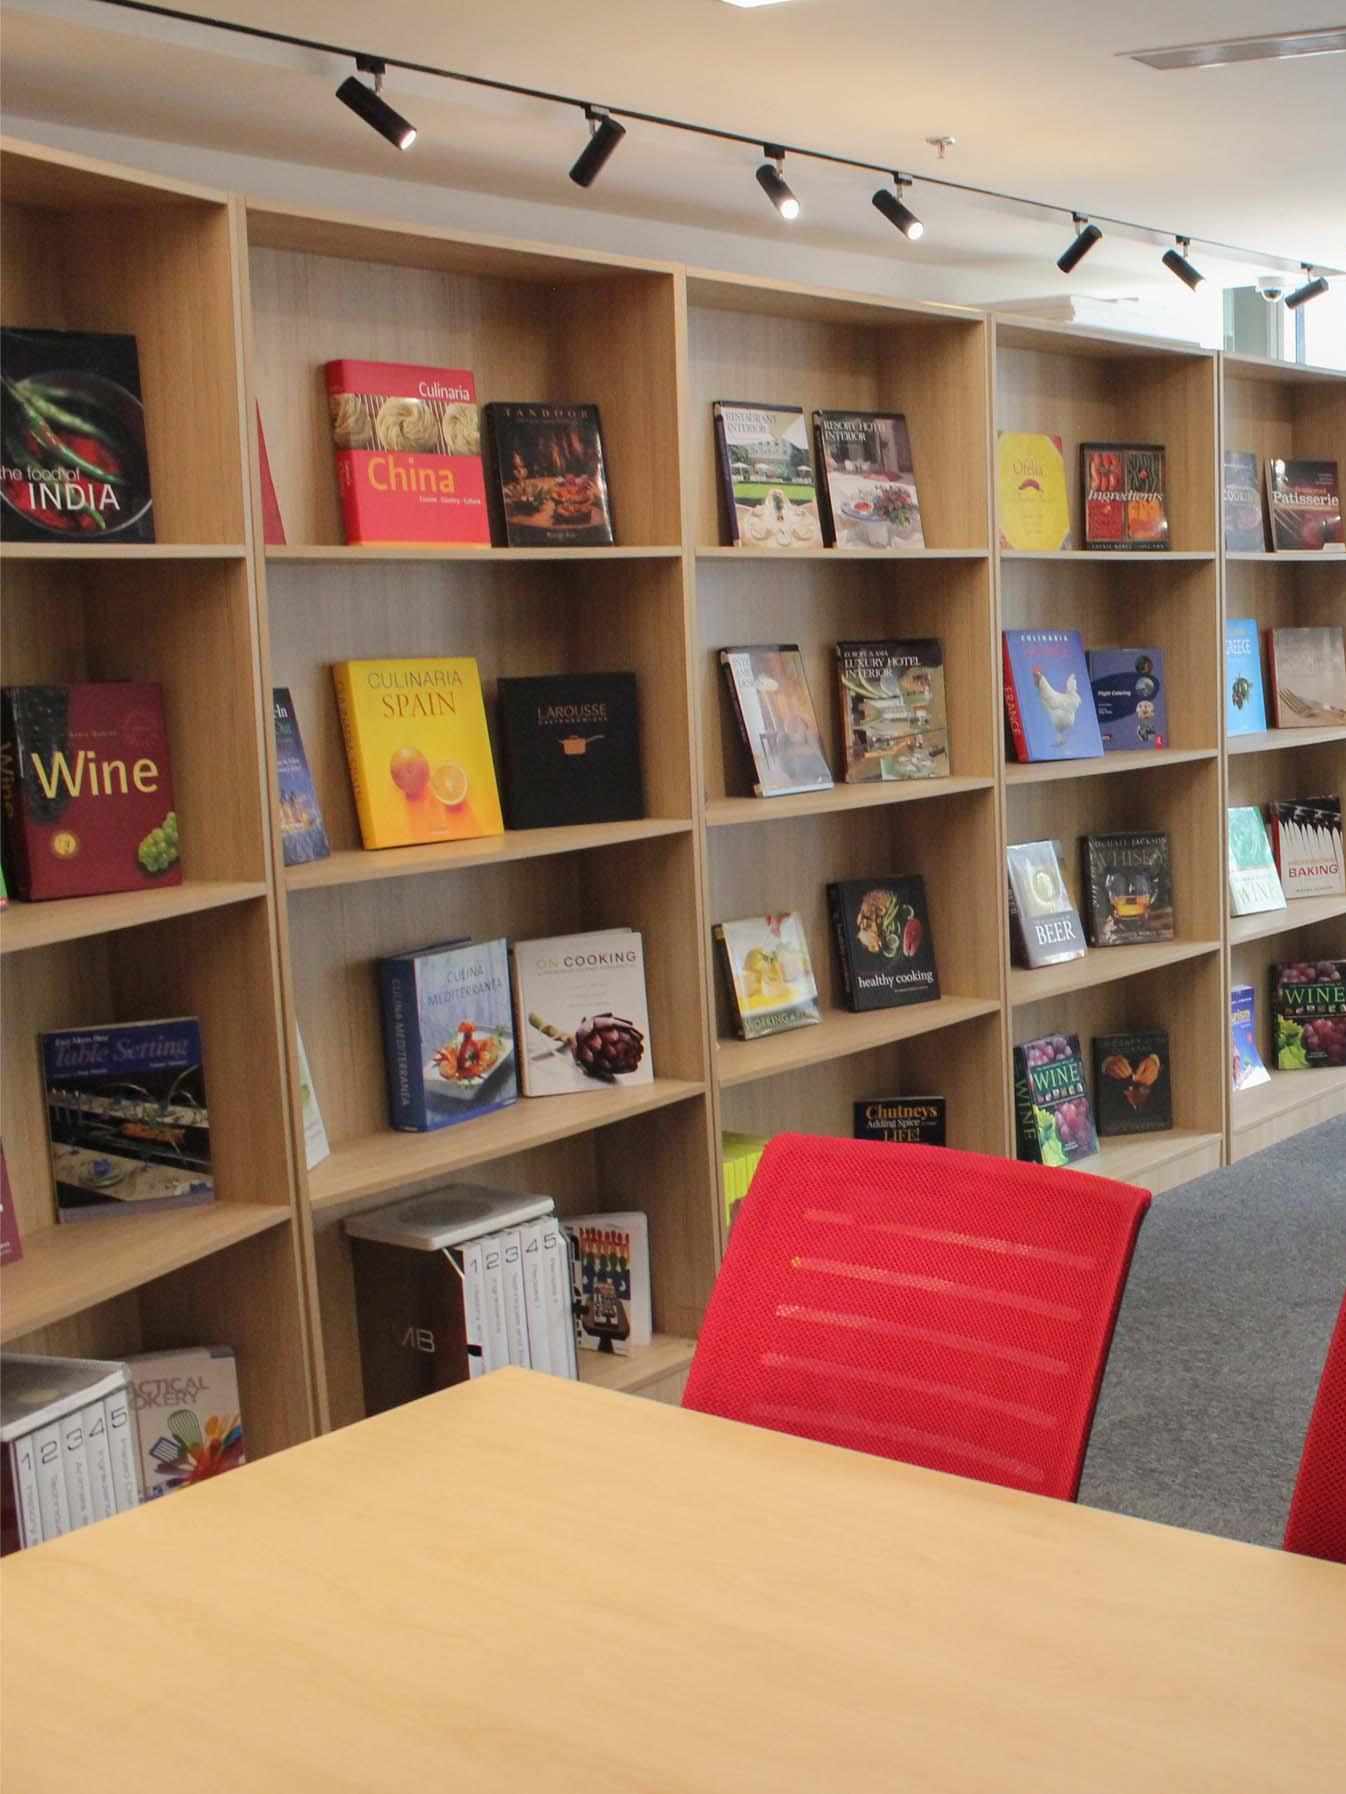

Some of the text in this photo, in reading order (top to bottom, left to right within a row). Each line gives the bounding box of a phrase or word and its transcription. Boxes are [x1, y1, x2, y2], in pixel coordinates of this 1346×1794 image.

[419, 381, 470, 401] Culinaria
[504, 407, 590, 418] TANDOOR
[726, 411, 777, 424] RESTAURANT
[823, 419, 858, 432] RESORT
[825, 431, 866, 441] INTERIOR
[28, 466, 64, 480] food
[68, 466, 80, 480] of
[368, 456, 455, 493] China
[29, 483, 120, 511] INDIA
[1087, 489, 1164, 502] Ingredients
[1272, 491, 1339, 505] Patisserie
[844, 656, 921, 669] LUXURY HOTEL
[367, 670, 464, 690] CULINARIA
[845, 668, 893, 680] INTERIOR
[382, 692, 457, 720] SPAIN
[537, 703, 607, 720] LAROUSSE
[1004, 687, 1022, 737] FRANCE
[31, 750, 159, 799] Wine
[1288, 864, 1339, 878] BAKING
[1035, 920, 1076, 945] BEER
[536, 958, 560, 970] ON
[563, 950, 638, 968] COOKING
[448, 965, 485, 984] CULINA
[858, 970, 934, 988] healthy cooking
[1285, 987, 1346, 1004] WINE
[55, 1035, 189, 1068] Table Setting
[1034, 1062, 1080, 1091] WINE
[865, 1104, 938, 1120] Chutneys
[1015, 1080, 1036, 1141] WINE
[867, 1119, 896, 1129] Adding
[897, 1119, 920, 1129] Spice
[884, 1128, 920, 1142] LIFE!
[525, 1239, 539, 1253] 4
[544, 1232, 557, 1249] 5
[486, 1251, 500, 1270] 2
[504, 1246, 518, 1263] 3
[470, 1258, 478, 1273] 1
[128, 1375, 210, 1394] ACTICAL
[132, 1389, 199, 1409] OKERY
[111, 1406, 127, 1428] 5
[89, 1417, 104, 1437] 4
[66, 1427, 82, 1451] 3
[22, 1452, 32, 1470] 1
[41, 1440, 58, 1464] 2
